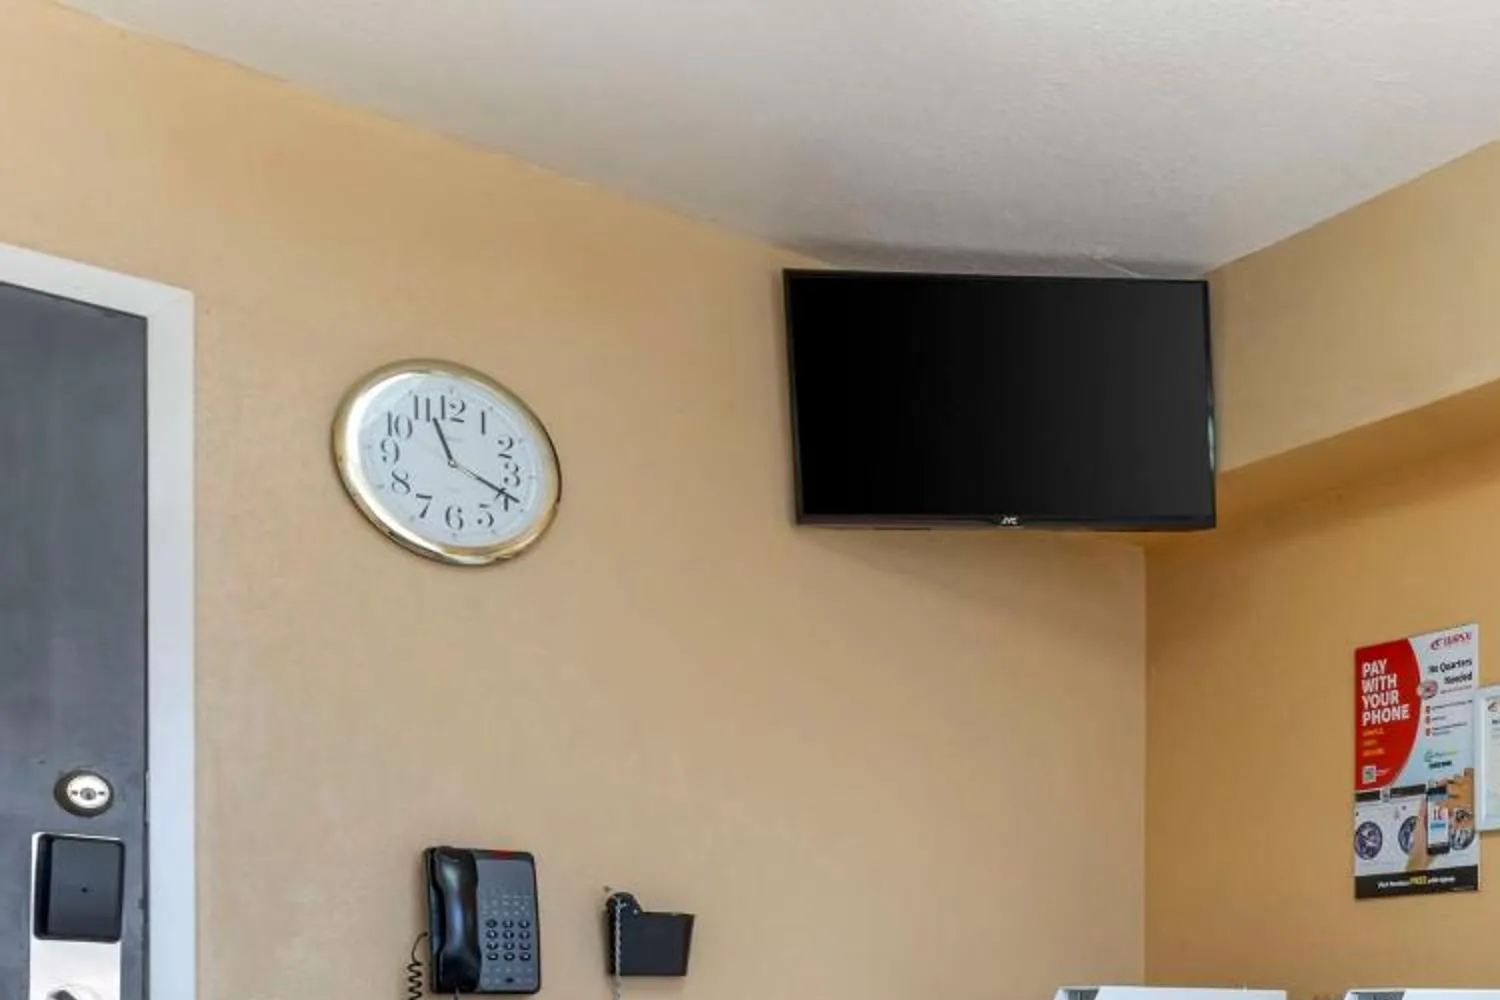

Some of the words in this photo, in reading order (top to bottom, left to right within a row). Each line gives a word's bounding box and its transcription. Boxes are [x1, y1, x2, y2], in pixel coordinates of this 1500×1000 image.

[413, 395, 431, 422] 11
[439, 395, 466, 423] 12
[386, 411, 413, 440] 10
[480, 410, 487, 436] 1
[380, 437, 400, 465] 9
[497, 434, 514, 459] 2
[391, 468, 411, 495] 8
[503, 462, 521, 488] 3
[415, 493, 433, 519] 7
[445, 504, 464, 531] 6
[477, 502, 494, 528] 5
[1362, 658, 1387, 677] PAY
[1362, 673, 1397, 694] WITH
[1362, 690, 1399, 710] YOUR
[1362, 703, 1410, 727] PHONE
